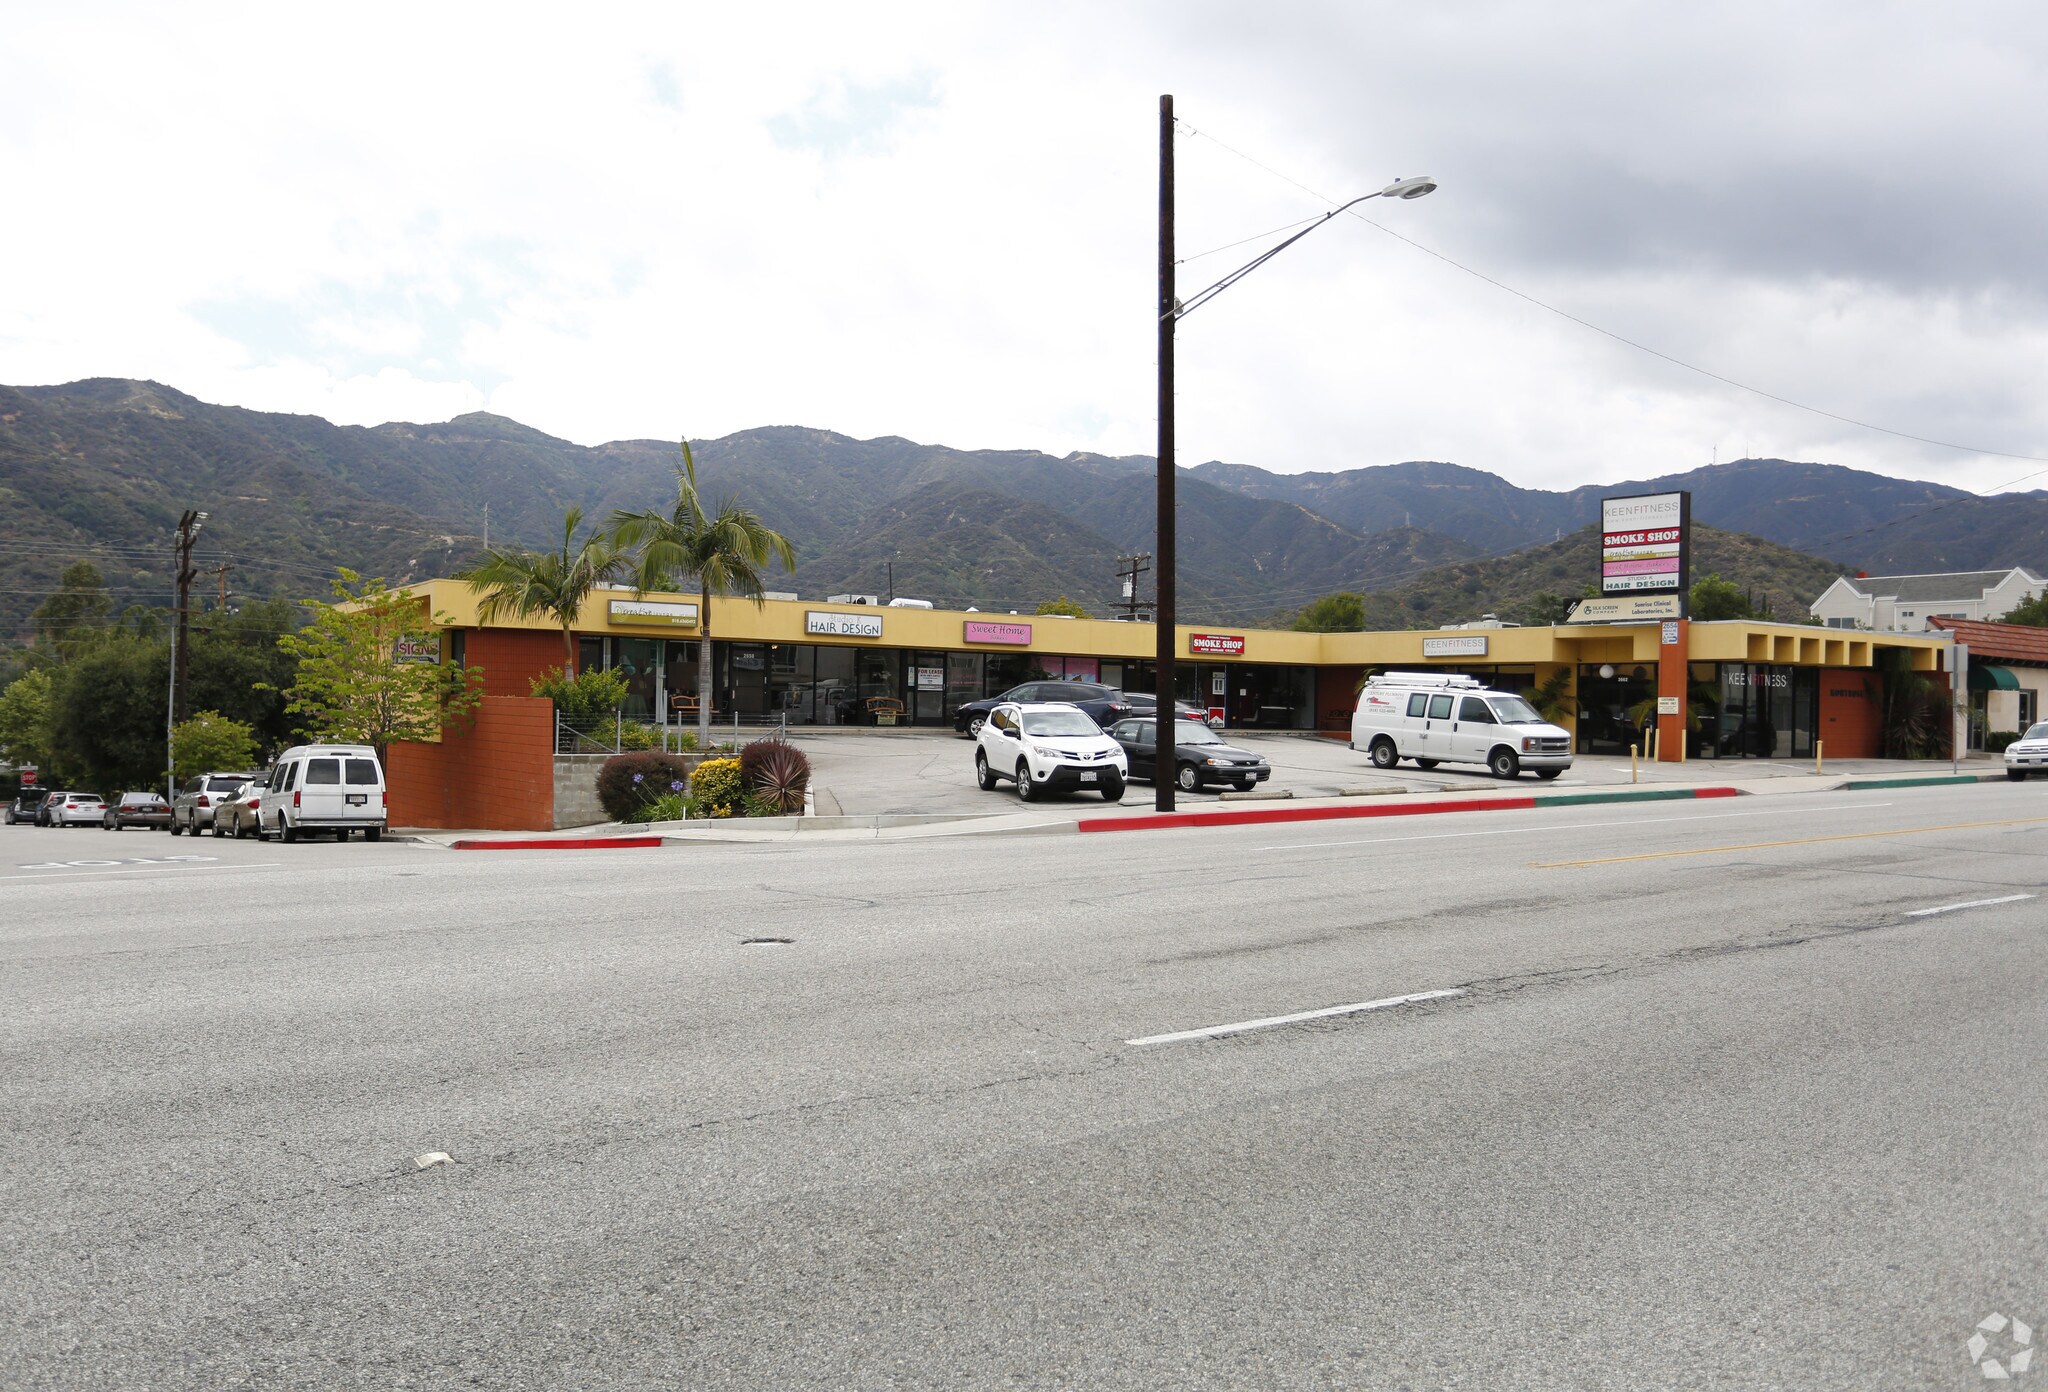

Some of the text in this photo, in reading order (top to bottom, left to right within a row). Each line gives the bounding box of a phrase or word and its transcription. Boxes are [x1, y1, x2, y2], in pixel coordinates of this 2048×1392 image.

[1604, 502, 1679, 517] KEENFITNESS
[1604, 530, 1679, 545] SMOKE SHOP
[810, 621, 879, 634] HAIR DESIGN
[972, 624, 1025, 635] Sweet Home
[1194, 639, 1242, 648] SMOKE SHOP
[1425, 639, 1483, 648] KEENFITNESS
